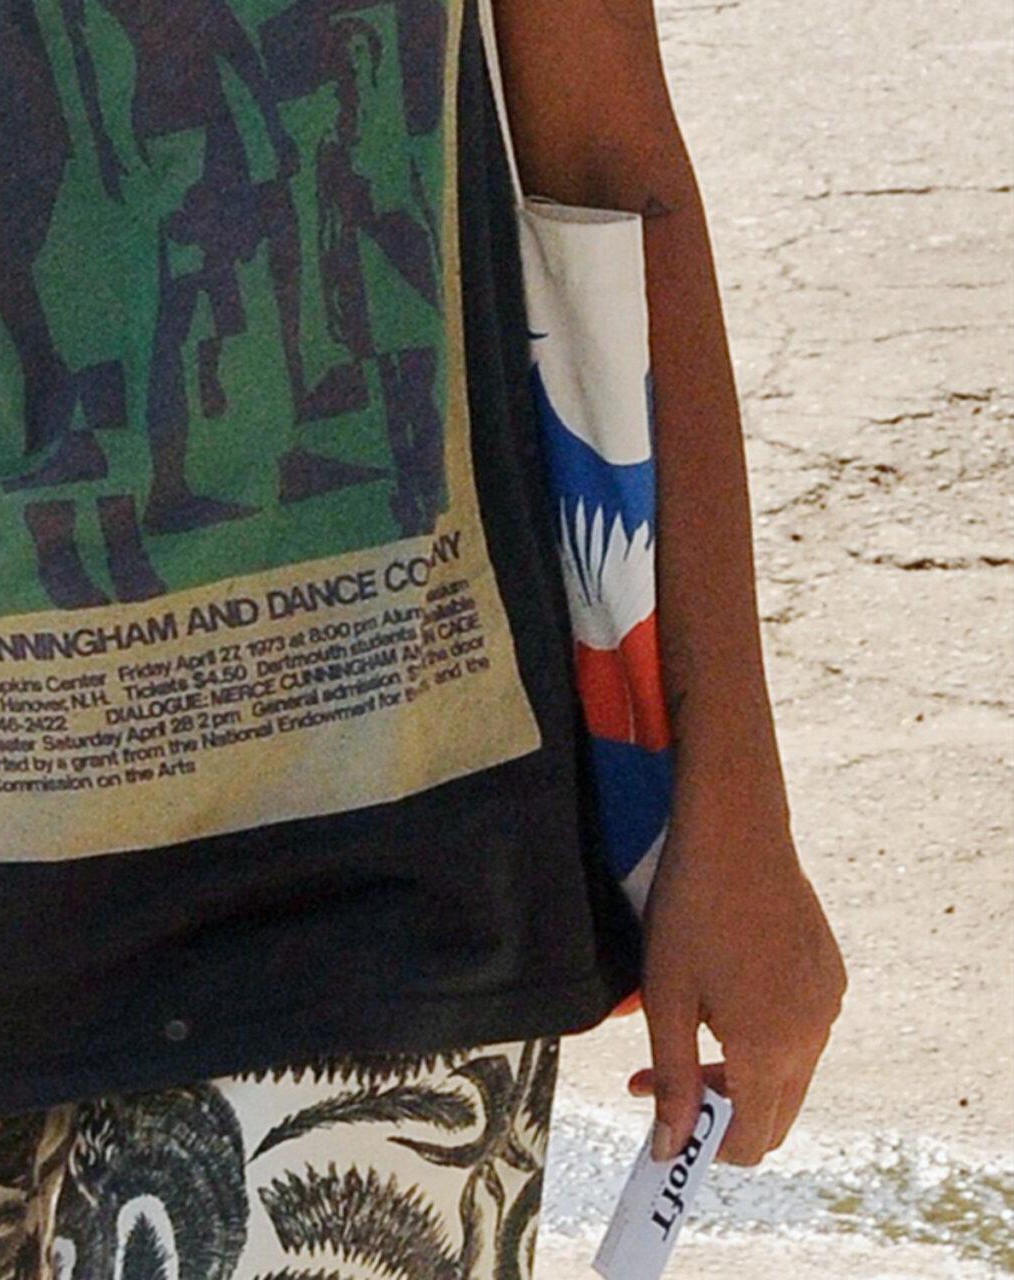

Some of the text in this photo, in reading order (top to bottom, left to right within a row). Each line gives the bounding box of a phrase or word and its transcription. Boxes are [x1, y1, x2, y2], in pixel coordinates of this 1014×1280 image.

[187, 597, 259, 636] AND
[267, 569, 379, 620] DANCE
[46, 671, 107, 693] Center
[118, 659, 172, 683] Friday
[176, 649, 217, 673] April
[246, 634, 286, 658] 1973
[288, 631, 305, 648] at
[309, 621, 351, 643] 8:00
[353, 617, 378, 636] pm
[105, 691, 209, 726] DIALOGUE:
[210, 677, 277, 706] MERCE
[279, 647, 399, 691] CUNNINGHAM
[122, 677, 188, 701] Tickets
[192, 663, 248, 690] $4.50
[257, 643, 348, 678] Dartmouth
[349, 626, 418, 656] students
[42, 731, 123, 752] Saturday
[127, 721, 166, 743] April
[170, 715, 195, 734] 28
[197, 711, 211, 729] 2
[212, 710, 242, 730] pm
[251, 688, 319, 718] General
[322, 668, 402, 702] admission
[450, 635, 485, 658] door
[32, 756, 53, 774] by
[57, 757, 68, 770] a
[71, 749, 119, 772] grant
[122, 743, 166, 763] from
[169, 737, 198, 754] the
[202, 721, 273, 750] National
[276, 694, 376, 734] Endowment
[379, 690, 402, 709] for
[96, 771, 122, 789] on
[125, 765, 155, 785] the
[158, 758, 197, 778] Arts
